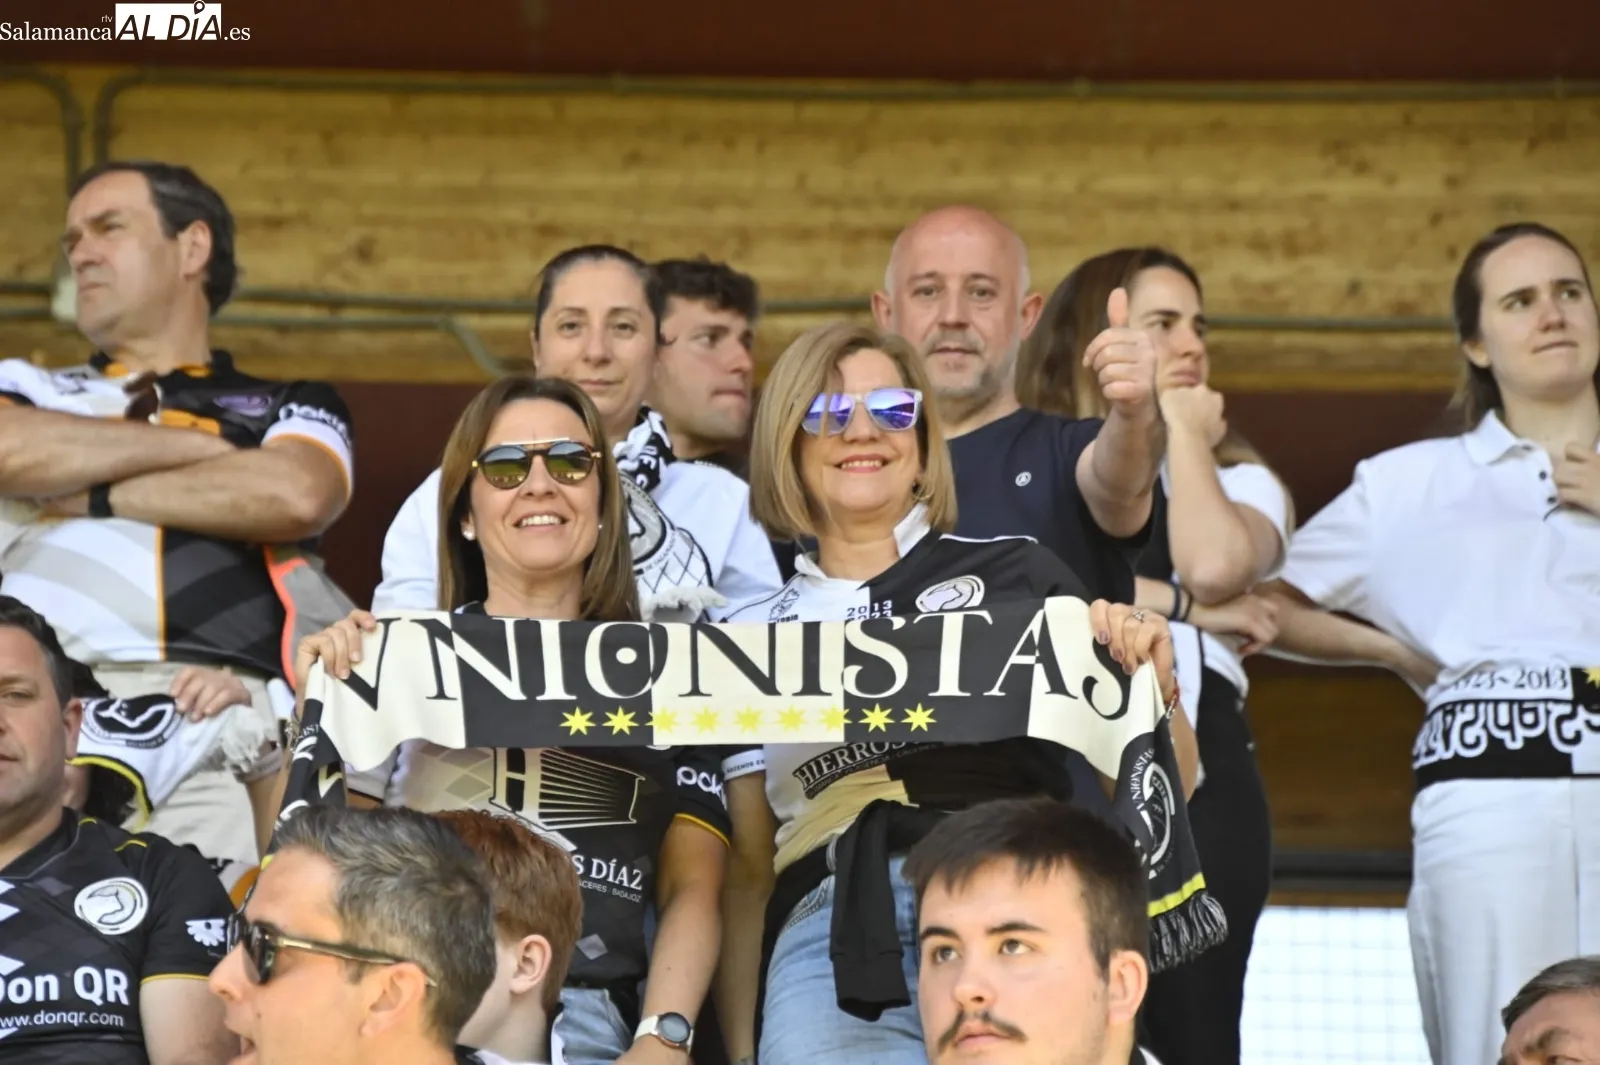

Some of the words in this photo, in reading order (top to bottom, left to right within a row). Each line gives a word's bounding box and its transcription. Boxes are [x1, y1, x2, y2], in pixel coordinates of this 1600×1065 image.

[847, 600, 893, 618] 2013
[0, 973, 60, 1005] on
[73, 965, 131, 1007] QR
[0, 1008, 125, 1028] ww.donqr.com
